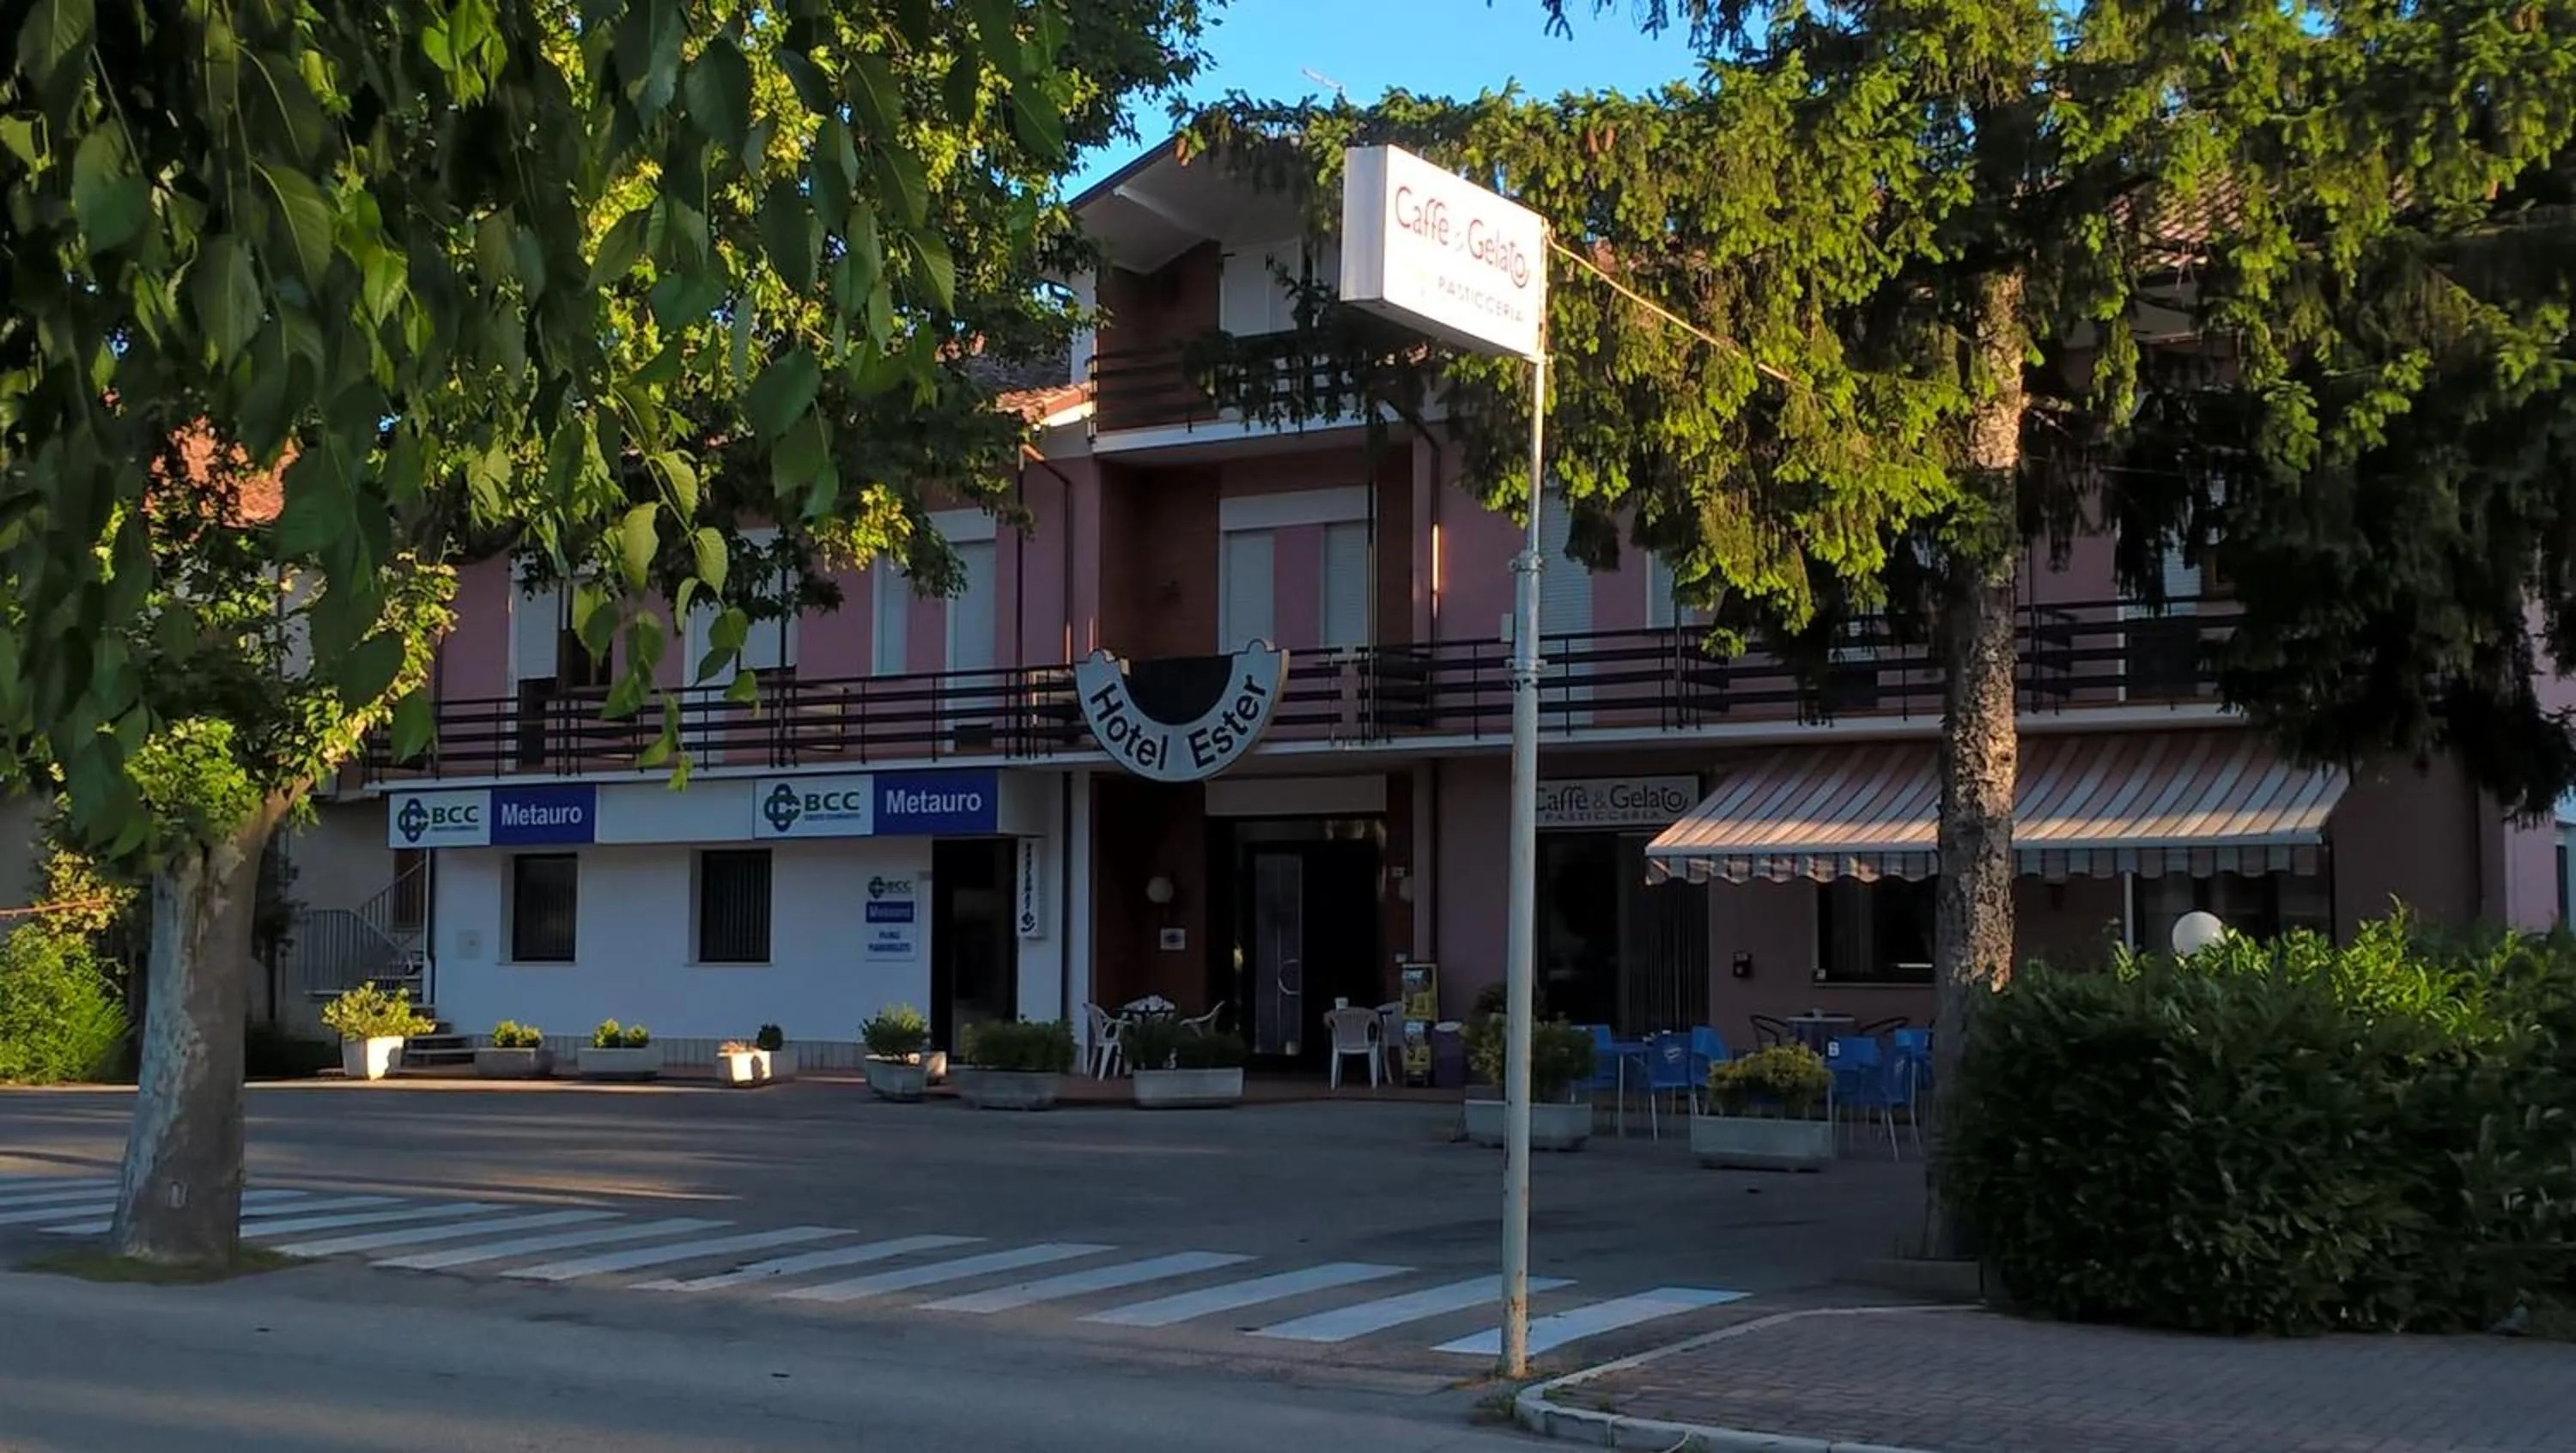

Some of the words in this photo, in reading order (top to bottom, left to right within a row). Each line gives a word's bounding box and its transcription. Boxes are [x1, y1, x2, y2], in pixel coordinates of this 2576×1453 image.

[1467, 218, 1530, 289] Gelato
[1089, 682, 1169, 771] Hotel
[1187, 673, 1267, 769] Ester
[805, 791, 860, 812] BCC
[885, 789, 982, 815] Metauro
[1609, 783, 1689, 814] Gelato
[431, 805, 480, 824] BCC
[501, 803, 583, 826] Metauro
